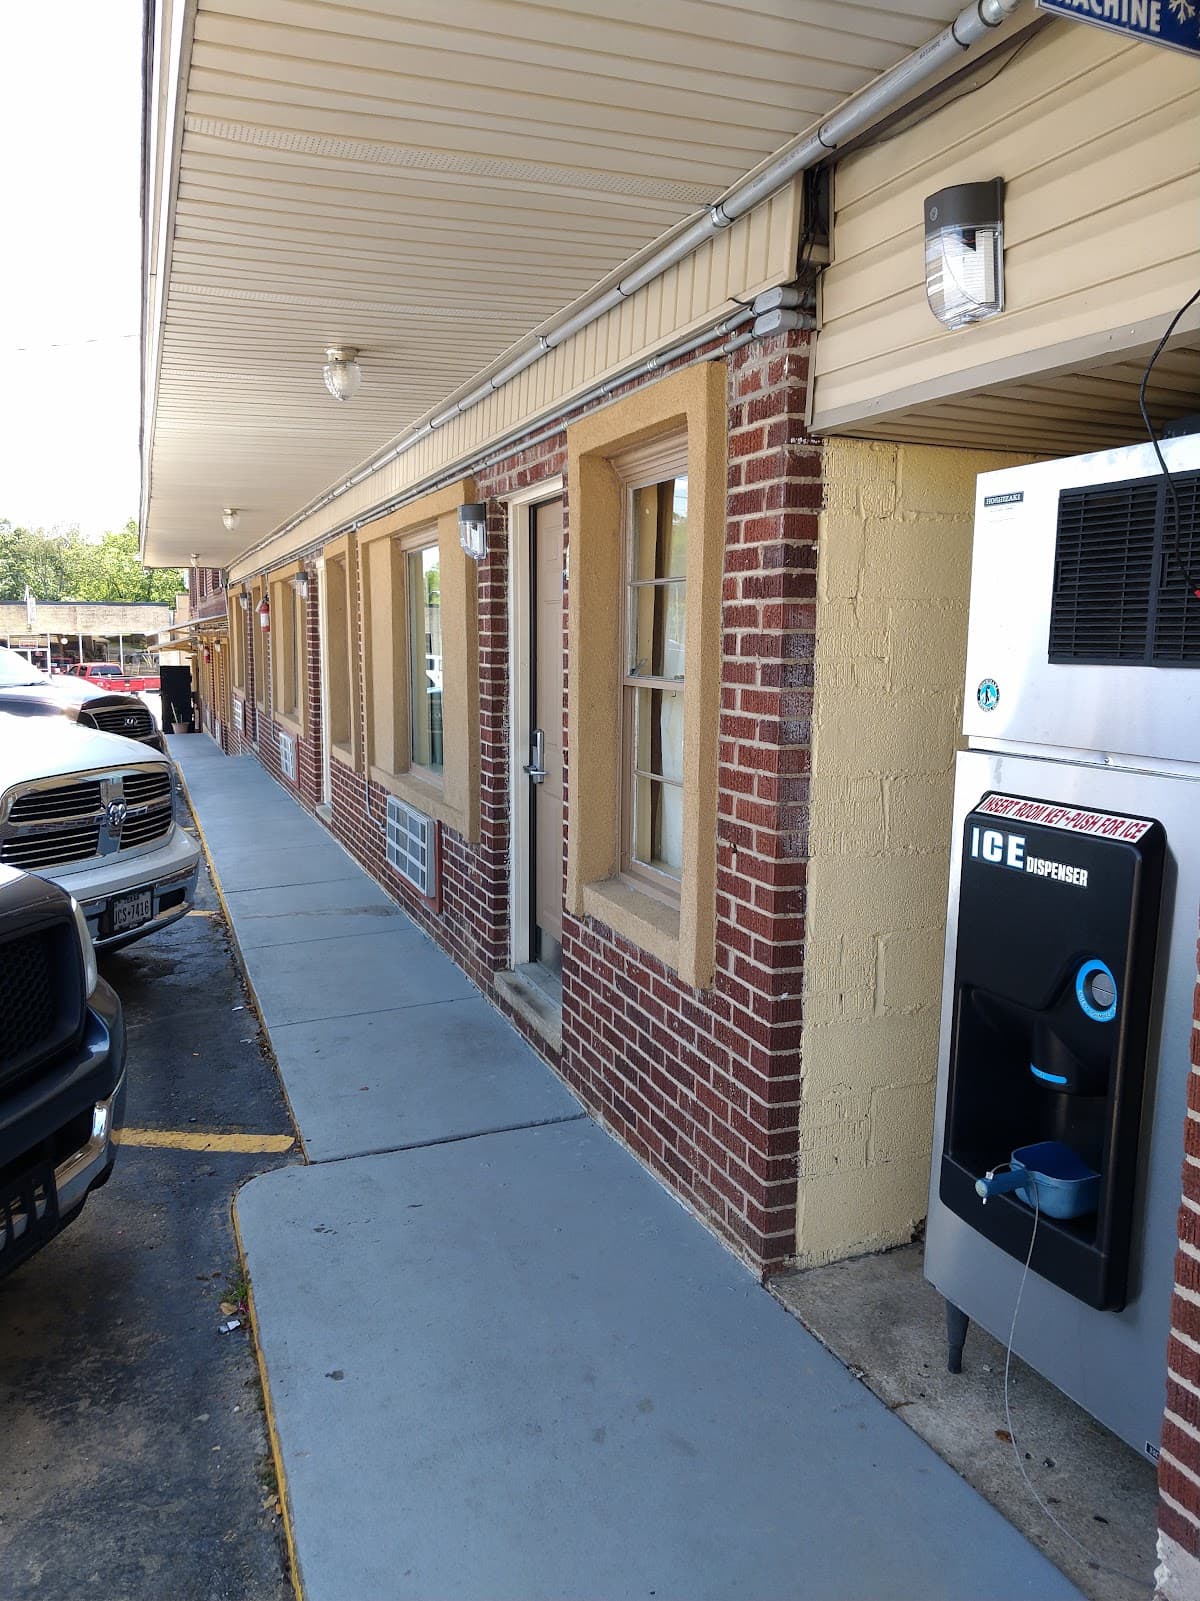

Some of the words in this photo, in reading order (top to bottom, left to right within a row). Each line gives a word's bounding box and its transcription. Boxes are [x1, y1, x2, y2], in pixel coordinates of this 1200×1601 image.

[1057, 0, 1161, 32] HINE
[979, 796, 1022, 815] INSERT
[1012, 802, 1048, 821] ROOM
[1095, 817, 1126, 836] FOR
[1119, 822, 1148, 839] ICE
[971, 826, 1025, 869] ICE
[1026, 855, 1088, 887] DISPENSER
